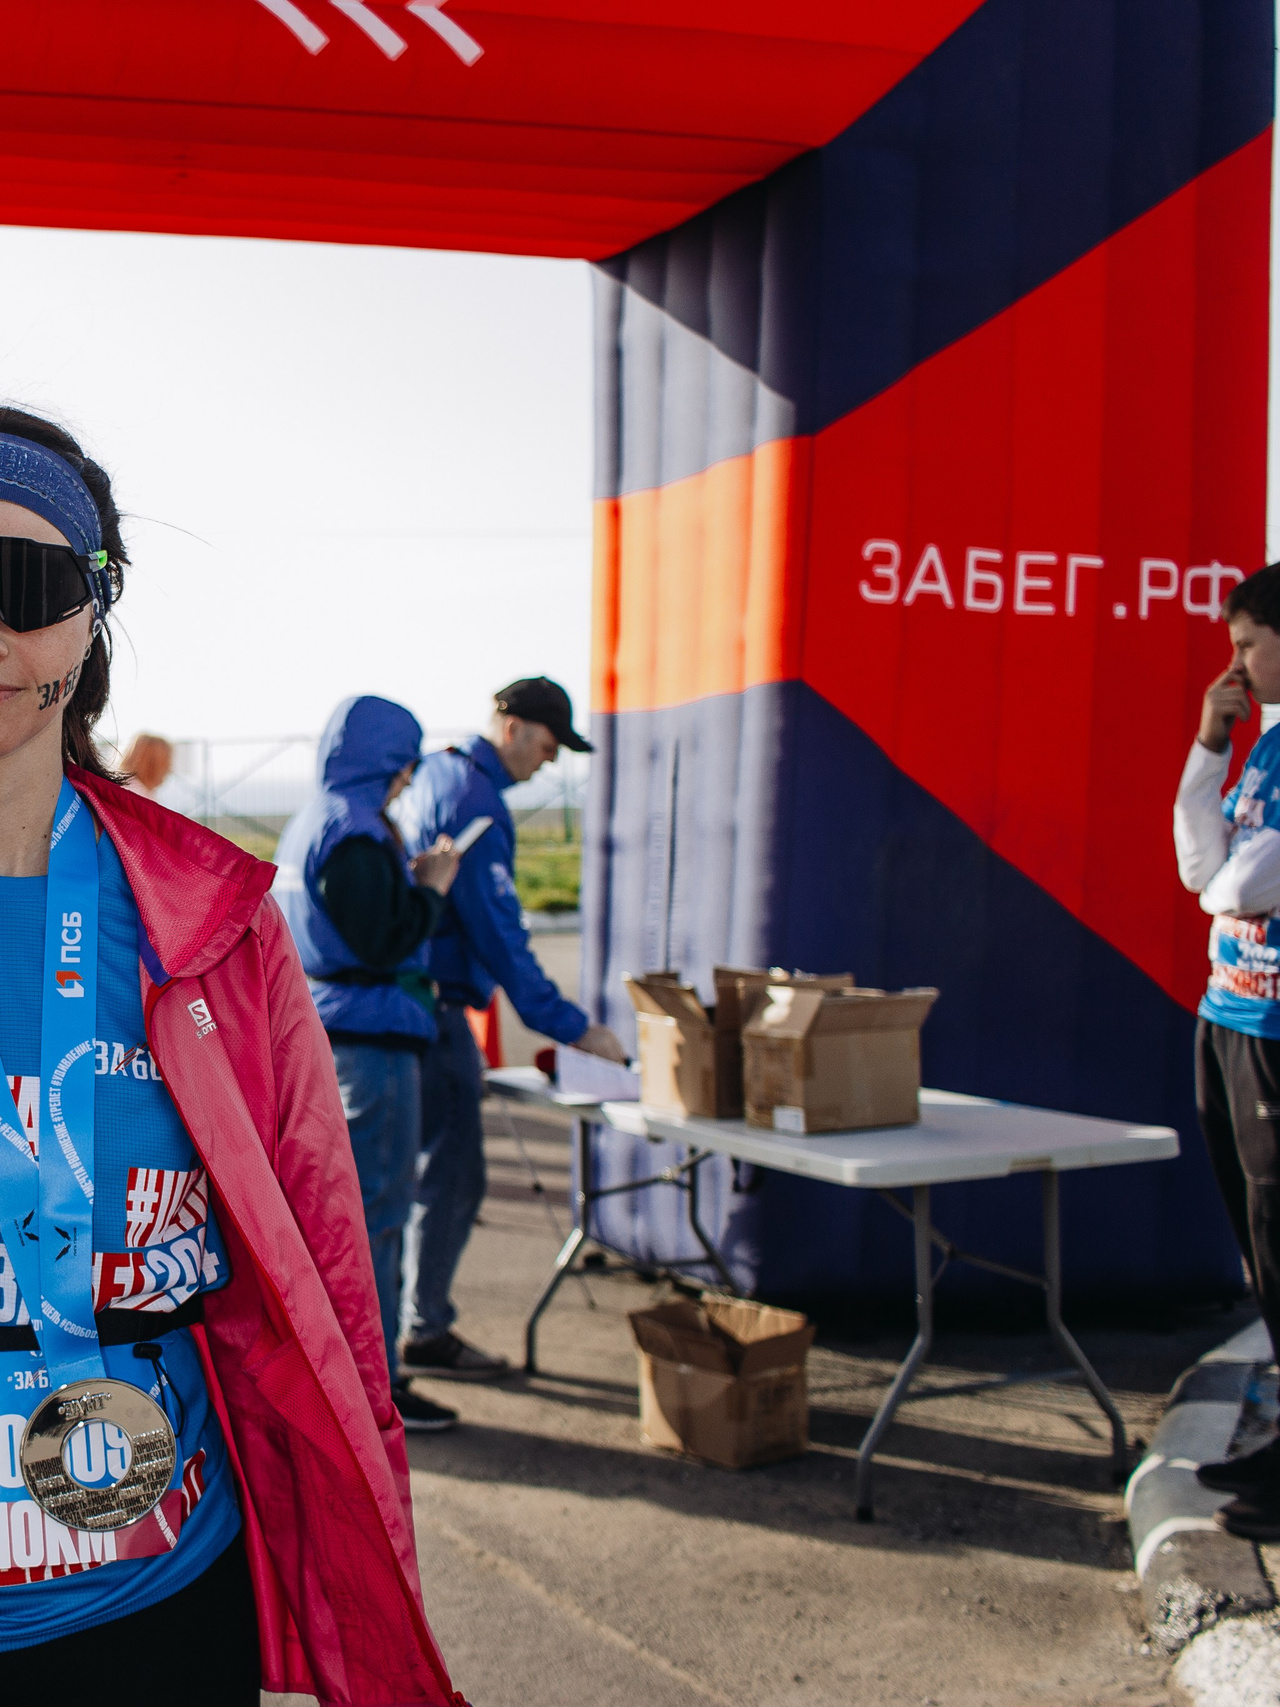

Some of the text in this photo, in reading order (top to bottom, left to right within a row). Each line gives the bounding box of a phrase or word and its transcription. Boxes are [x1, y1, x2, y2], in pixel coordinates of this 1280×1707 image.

[859, 538, 1246, 622] ЗАБЕГ.РФ
[61, 911, 82, 963] ПСБ
[48, 1087, 62, 1122] #ТРЕПЕТ
[59, 1317, 99, 1340] #СВОБОД
[7, 1367, 51, 1391] #ЗАБ
